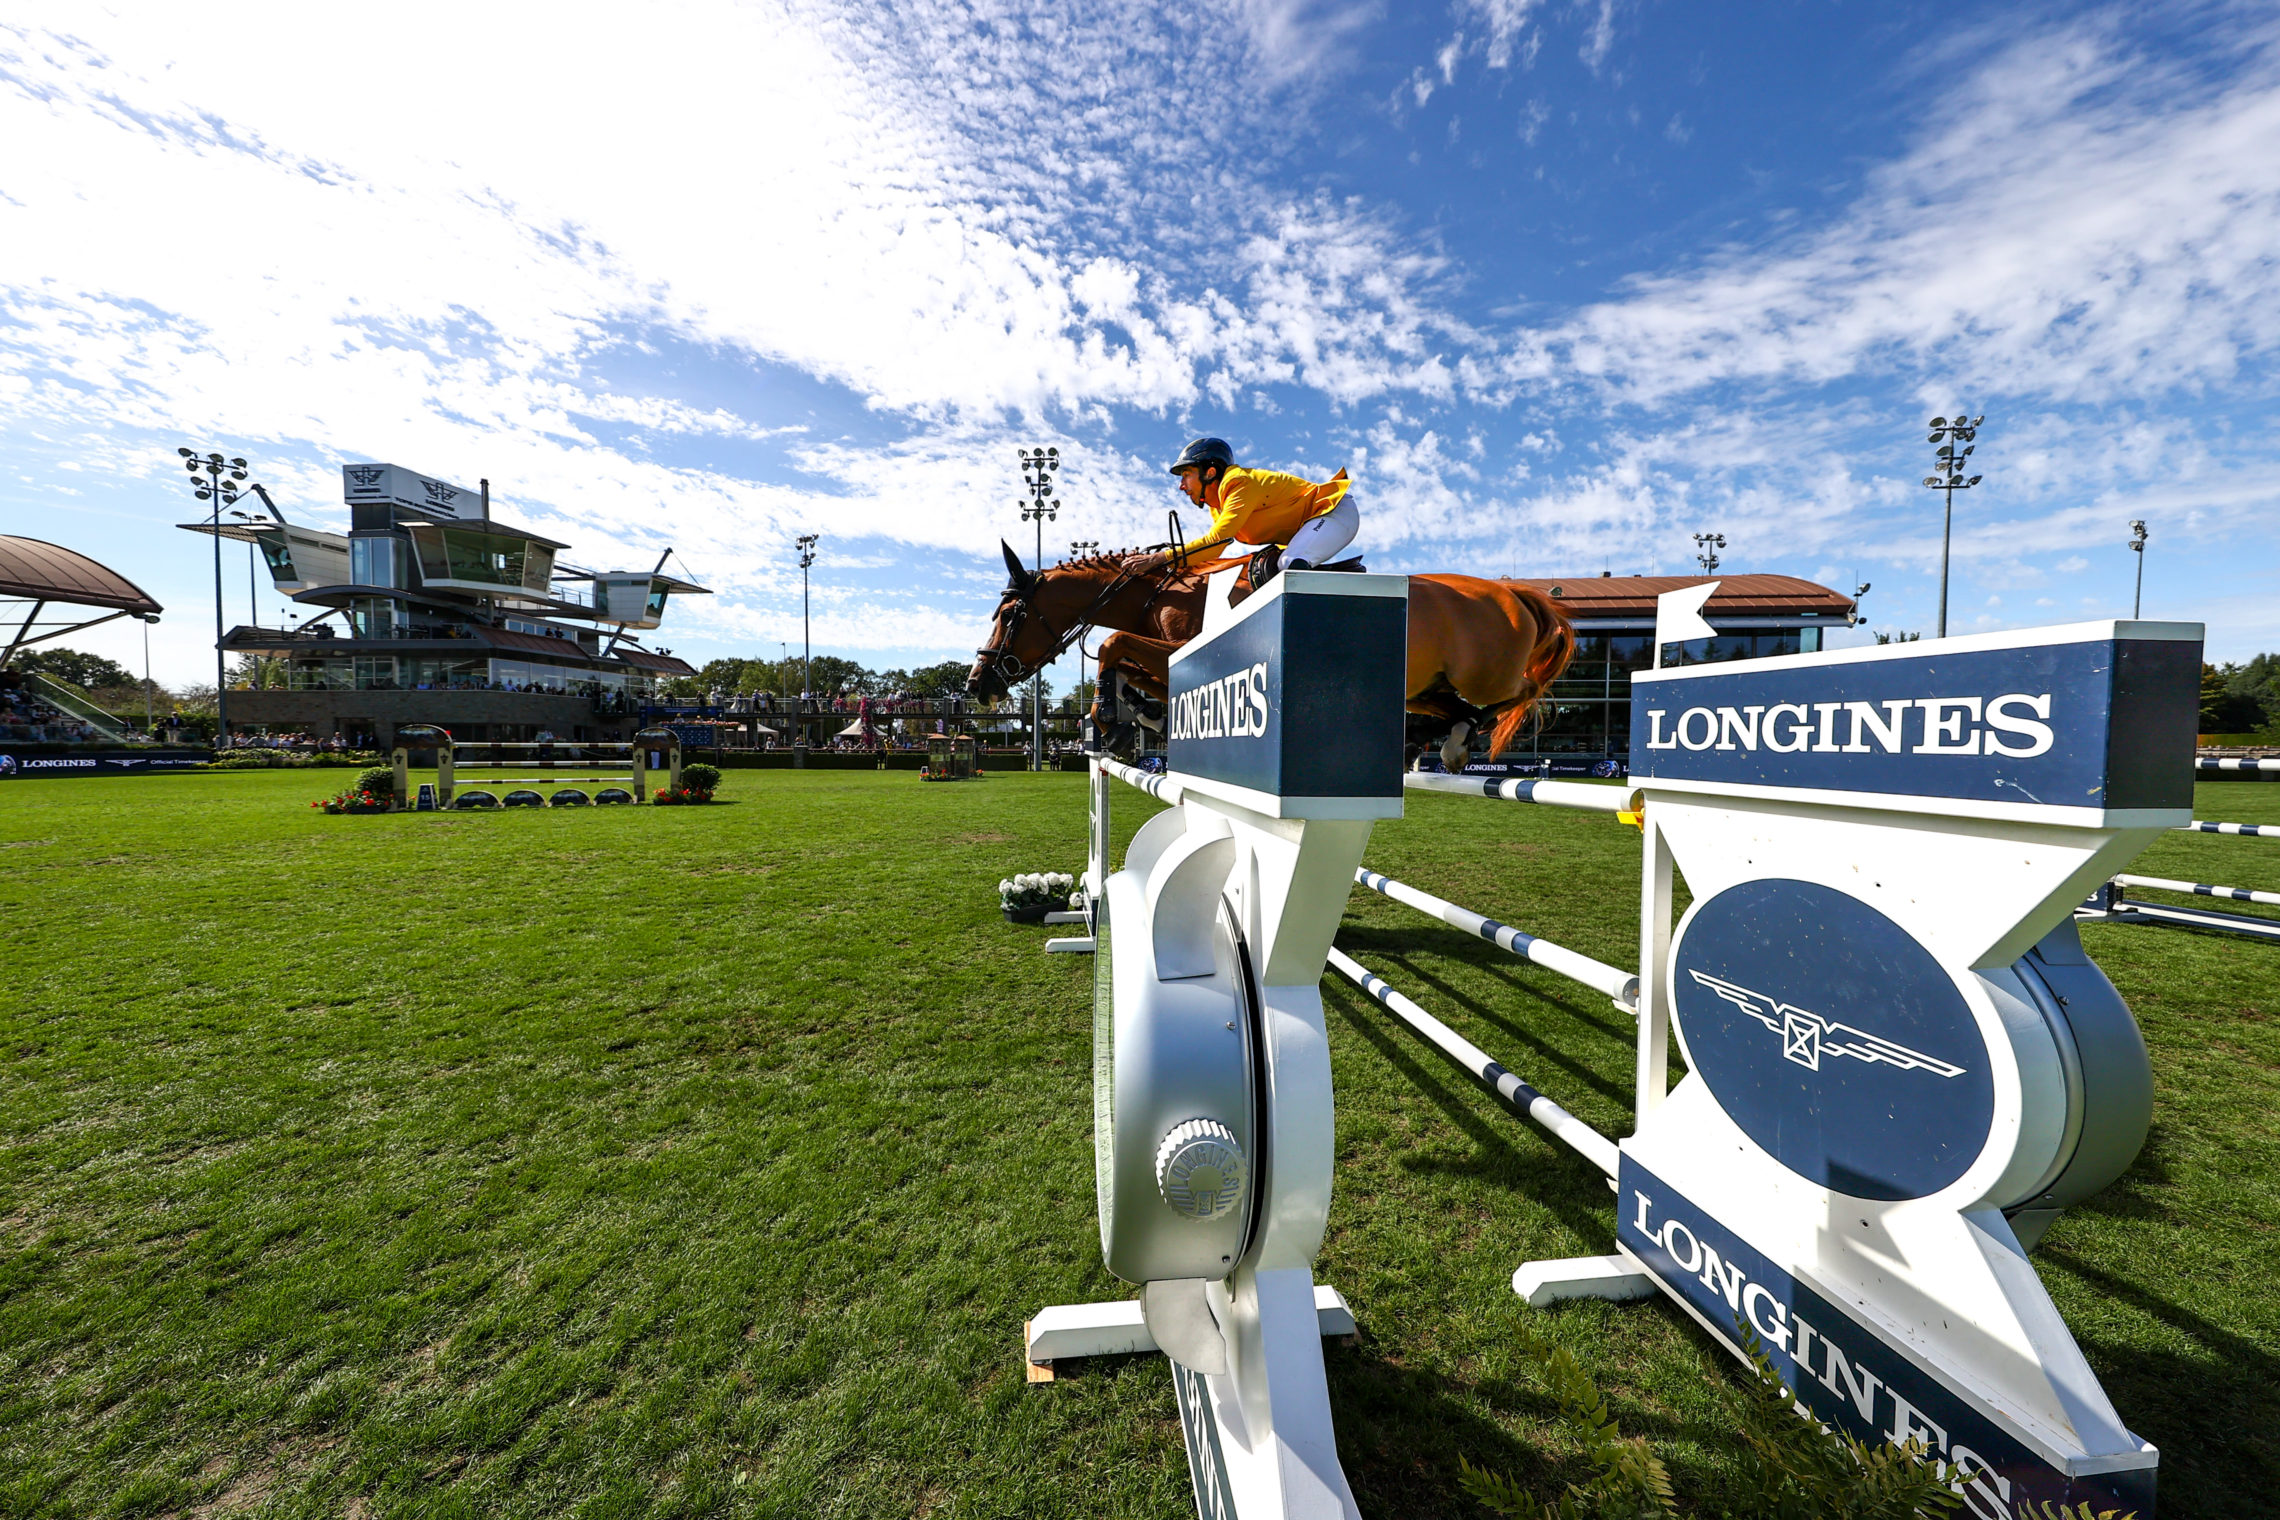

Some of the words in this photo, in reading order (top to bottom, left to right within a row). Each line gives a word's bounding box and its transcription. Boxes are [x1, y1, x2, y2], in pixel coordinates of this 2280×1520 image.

[1171, 662, 1268, 740] LONGINES
[1646, 693, 2055, 758] LONGINES
[22, 759, 97, 768] LONGINES
[1464, 764, 1508, 772] LONGINES
[1170, 1145, 1240, 1190] LONGINES
